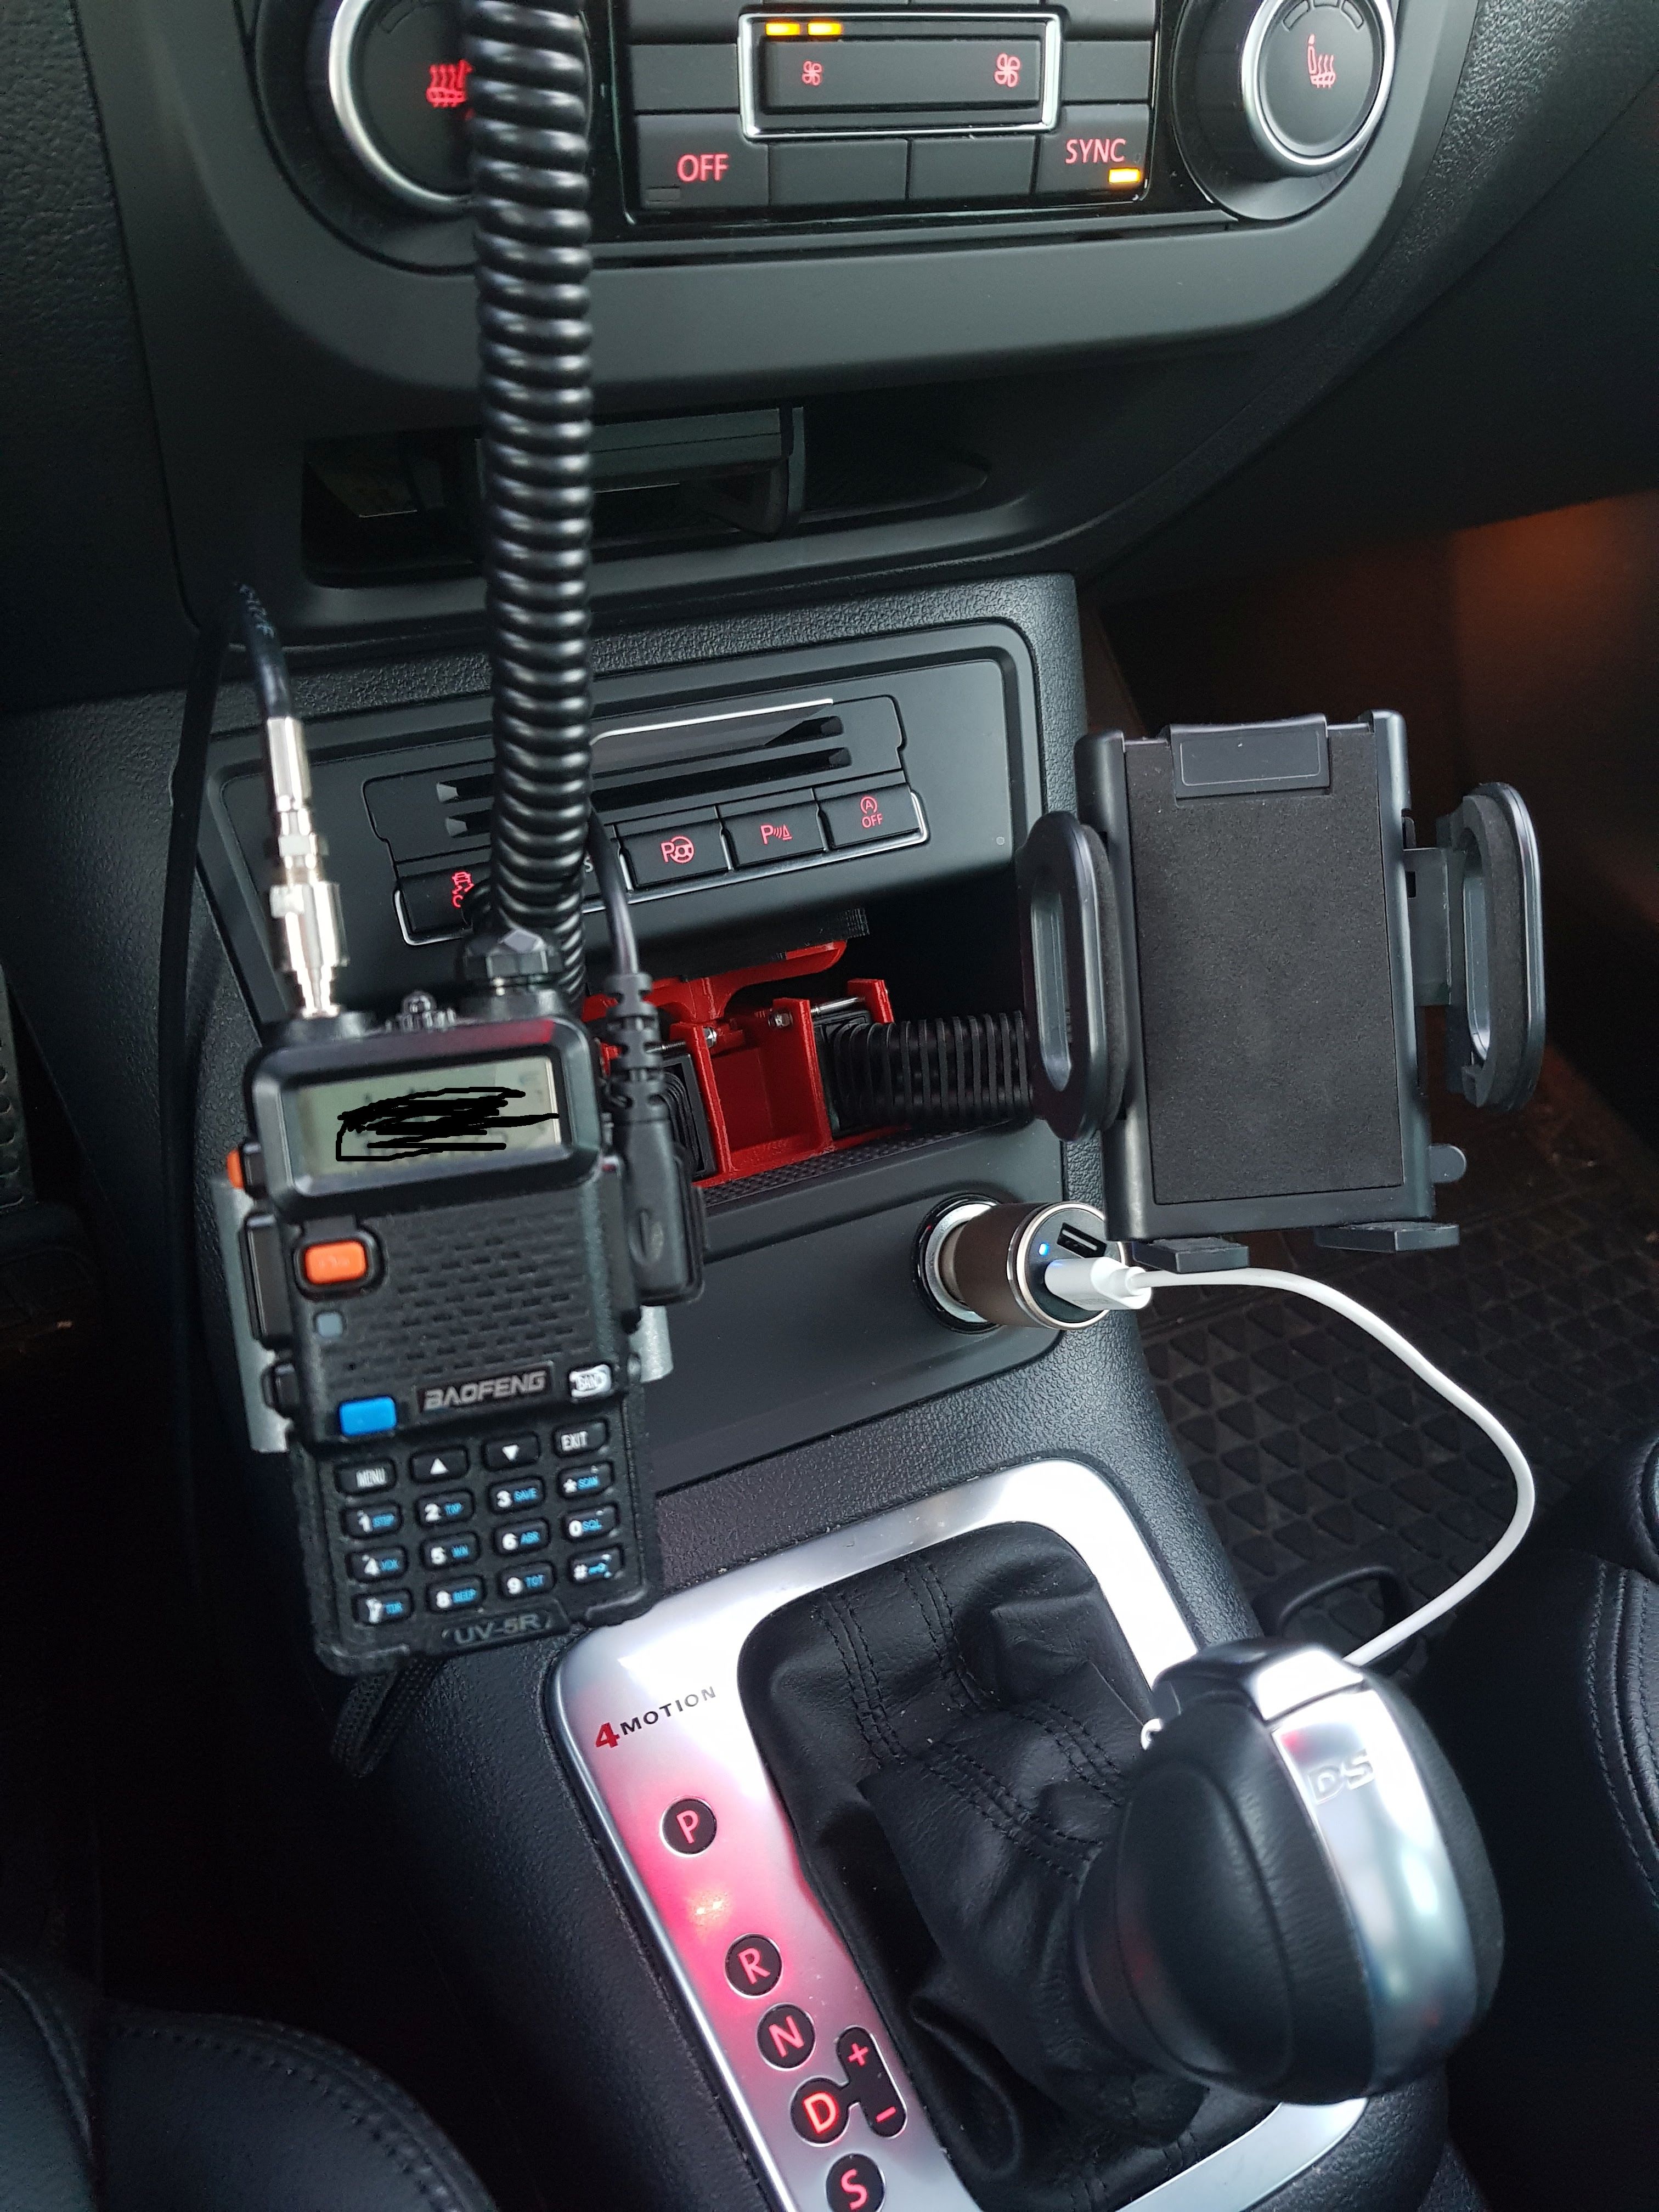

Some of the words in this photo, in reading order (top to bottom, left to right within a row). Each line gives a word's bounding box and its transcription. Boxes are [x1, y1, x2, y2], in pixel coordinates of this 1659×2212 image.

[1066, 138, 1127, 164] SYNC
[676, 153, 729, 183] OFF
[862, 813, 882, 828] OFF
[424, 1370, 548, 1410] BAOFENG
[561, 1431, 586, 1451] EXIT
[357, 1469, 386, 1487] MENU
[497, 1491, 512, 1507] 3
[514, 1488, 537, 1502] SAVE
[358, 1513, 373, 1532] 1
[425, 1504, 440, 1521] 2
[569, 1520, 583, 1537] 0
[503, 1533, 517, 1550] 6
[431, 1547, 445, 1564] 5
[507, 1577, 522, 1594] 9
[437, 1591, 452, 1608] 8
[454, 1614, 541, 1644] UV-5R
[595, 1686, 716, 1748] 4MOTION
[676, 1810, 699, 1844] P
[741, 1948, 770, 1984] R
[769, 2017, 805, 2050] N
[803, 2092, 837, 2134] D
[842, 2169, 868, 2210] S
